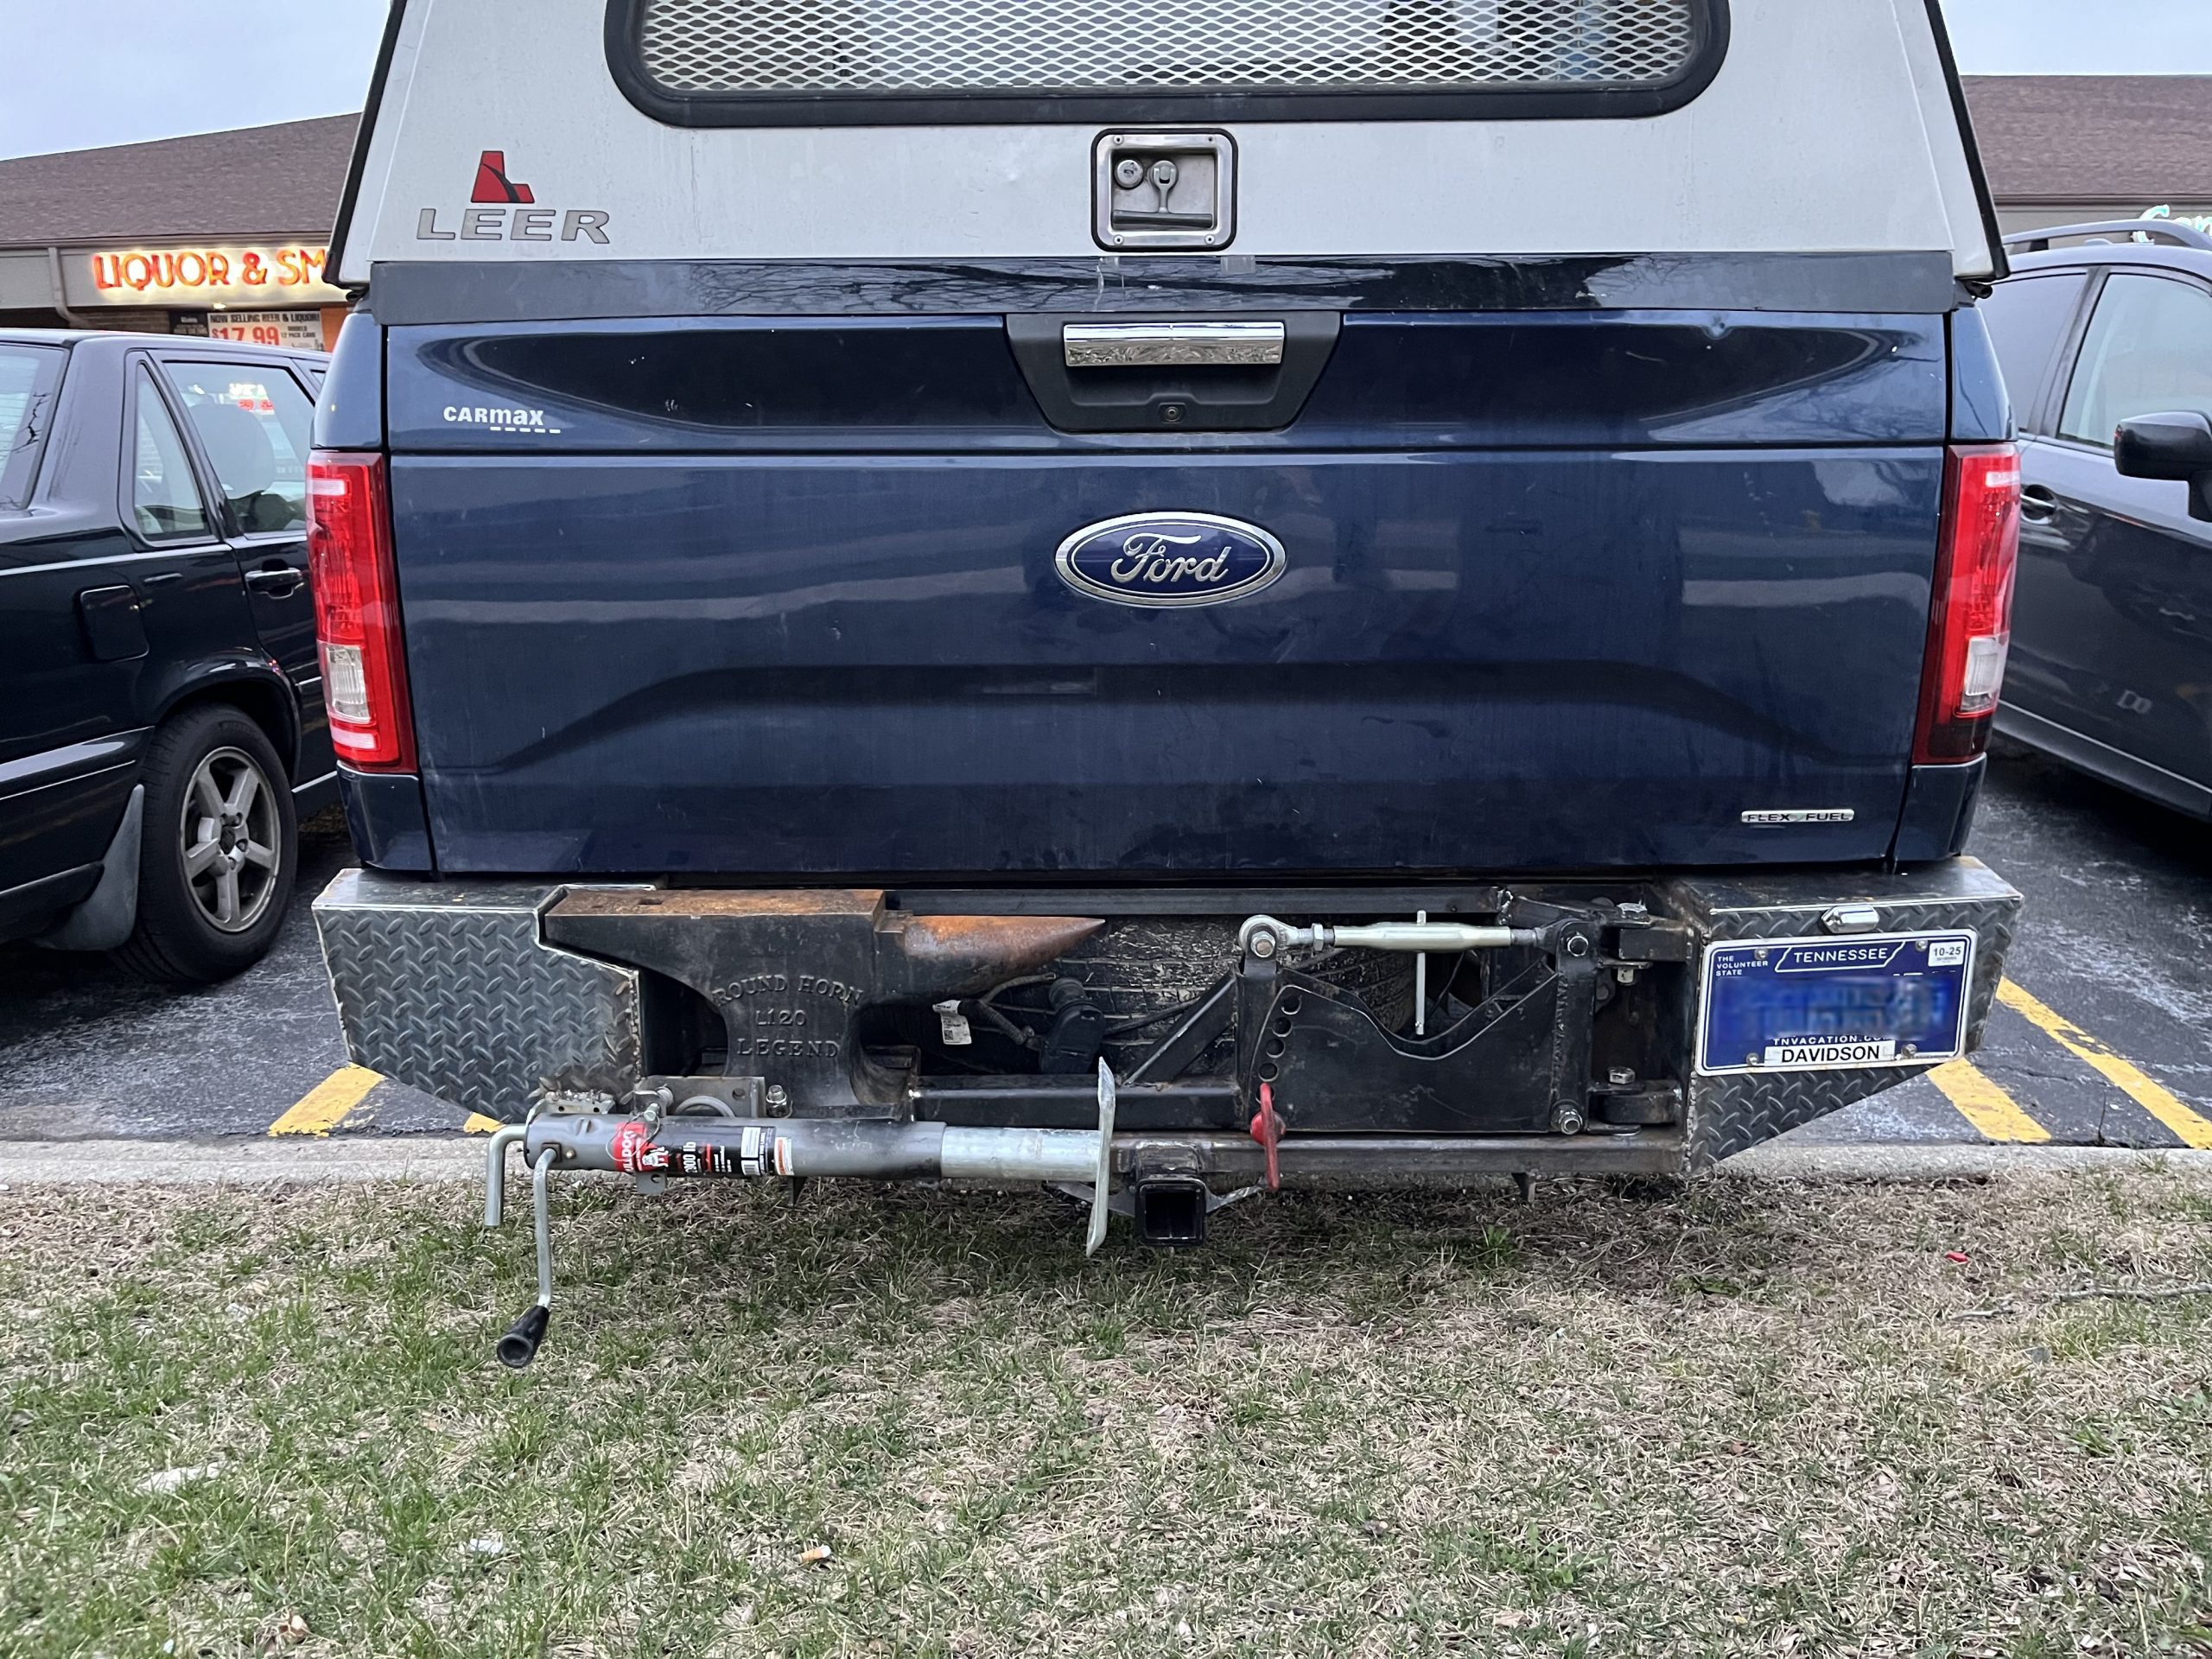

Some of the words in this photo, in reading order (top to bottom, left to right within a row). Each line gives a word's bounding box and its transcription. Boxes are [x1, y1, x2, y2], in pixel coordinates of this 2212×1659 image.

[416, 208, 610, 244] LEER
[92, 251, 230, 290] LIQUOR
[242, 251, 267, 285] &
[210, 315, 228, 323] NOW
[231, 314, 260, 323] SELLING
[262, 314, 280, 322] BEER
[211, 327, 279, 346] $1799
[1111, 533, 1231, 582] Ford
[1747, 813, 1790, 822] FLEX
[1805, 812, 1849, 821] FUEL
[1794, 948, 1888, 963] TENNESSEE
[1934, 946, 1961, 957] 10-25
[1716, 960, 1769, 969] VOLUNTEER
[712, 974, 787, 1007] ROUND
[798, 975, 863, 1005] HORN
[755, 1008, 808, 1027] L120
[737, 1038, 841, 1058] LEGEND
[1773, 1034, 1889, 1046] TNVACATION.CO
[1782, 1046, 1879, 1063] DAVIDSON
[621, 1131, 636, 1172] ULLDOG
[683, 1141, 696, 1152] lb
